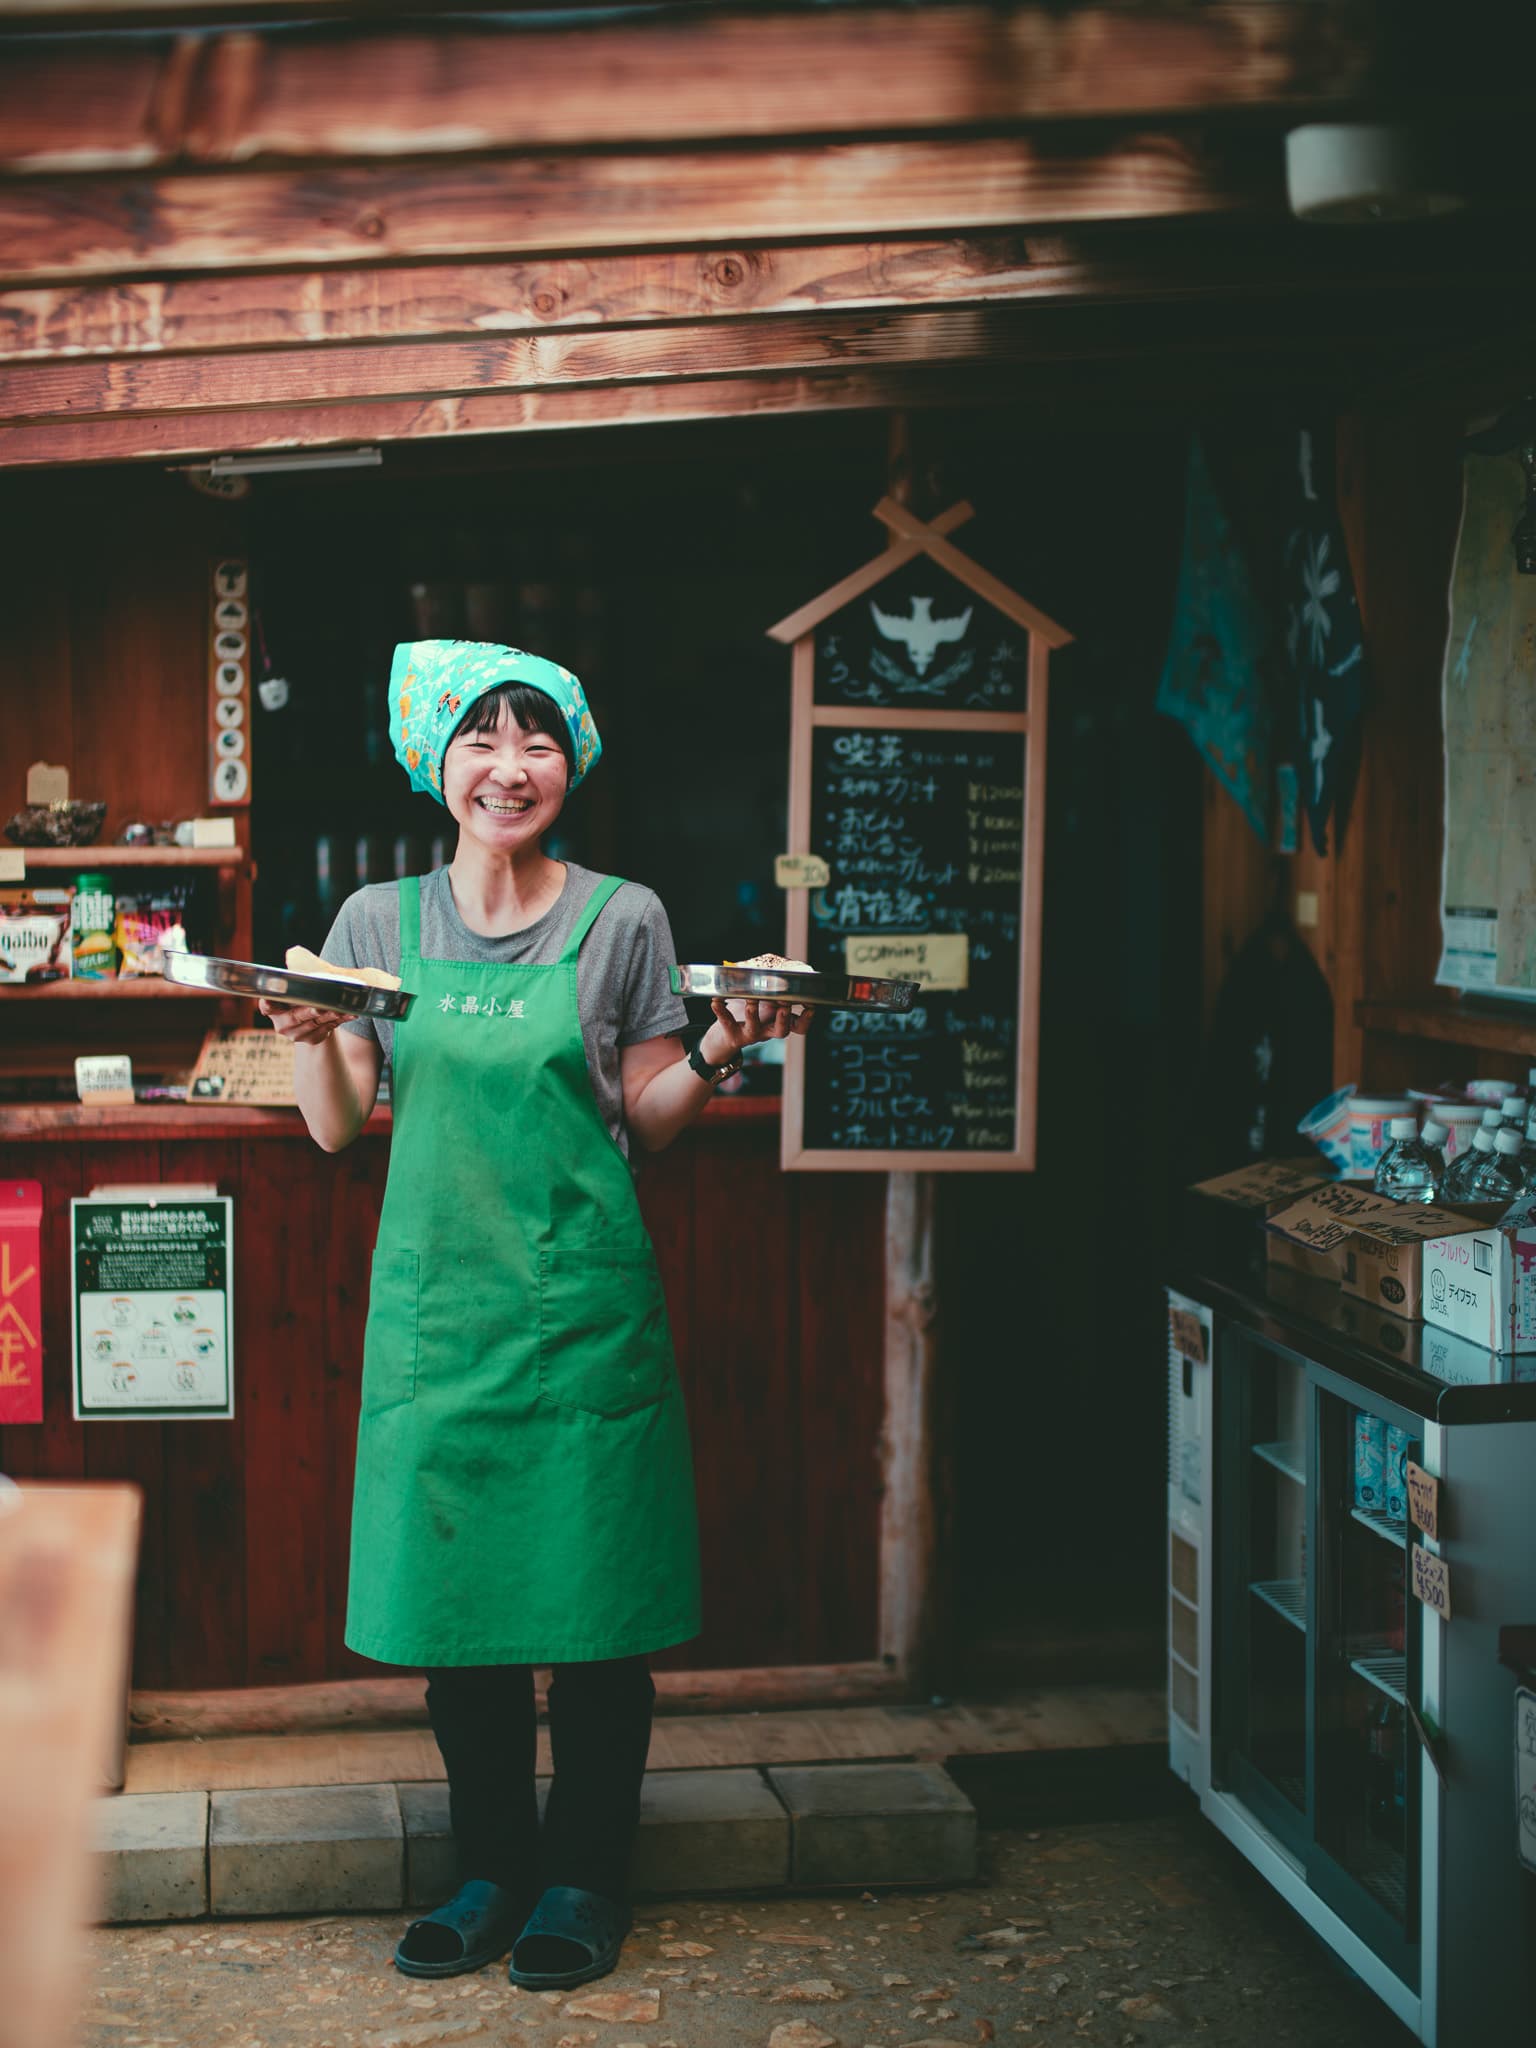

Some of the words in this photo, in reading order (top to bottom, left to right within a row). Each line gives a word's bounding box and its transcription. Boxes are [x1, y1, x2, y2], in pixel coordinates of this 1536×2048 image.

[2, 931, 48, 951] galbo
[436, 993, 526, 1019] 水晶小屋
[840, 1044, 920, 1069] コーヒー
[843, 1071, 912, 1095] ココア
[845, 1093, 935, 1118] カルピス
[845, 1124, 953, 1149] ホットミルク
[1416, 1572, 1445, 1611] ¥500
